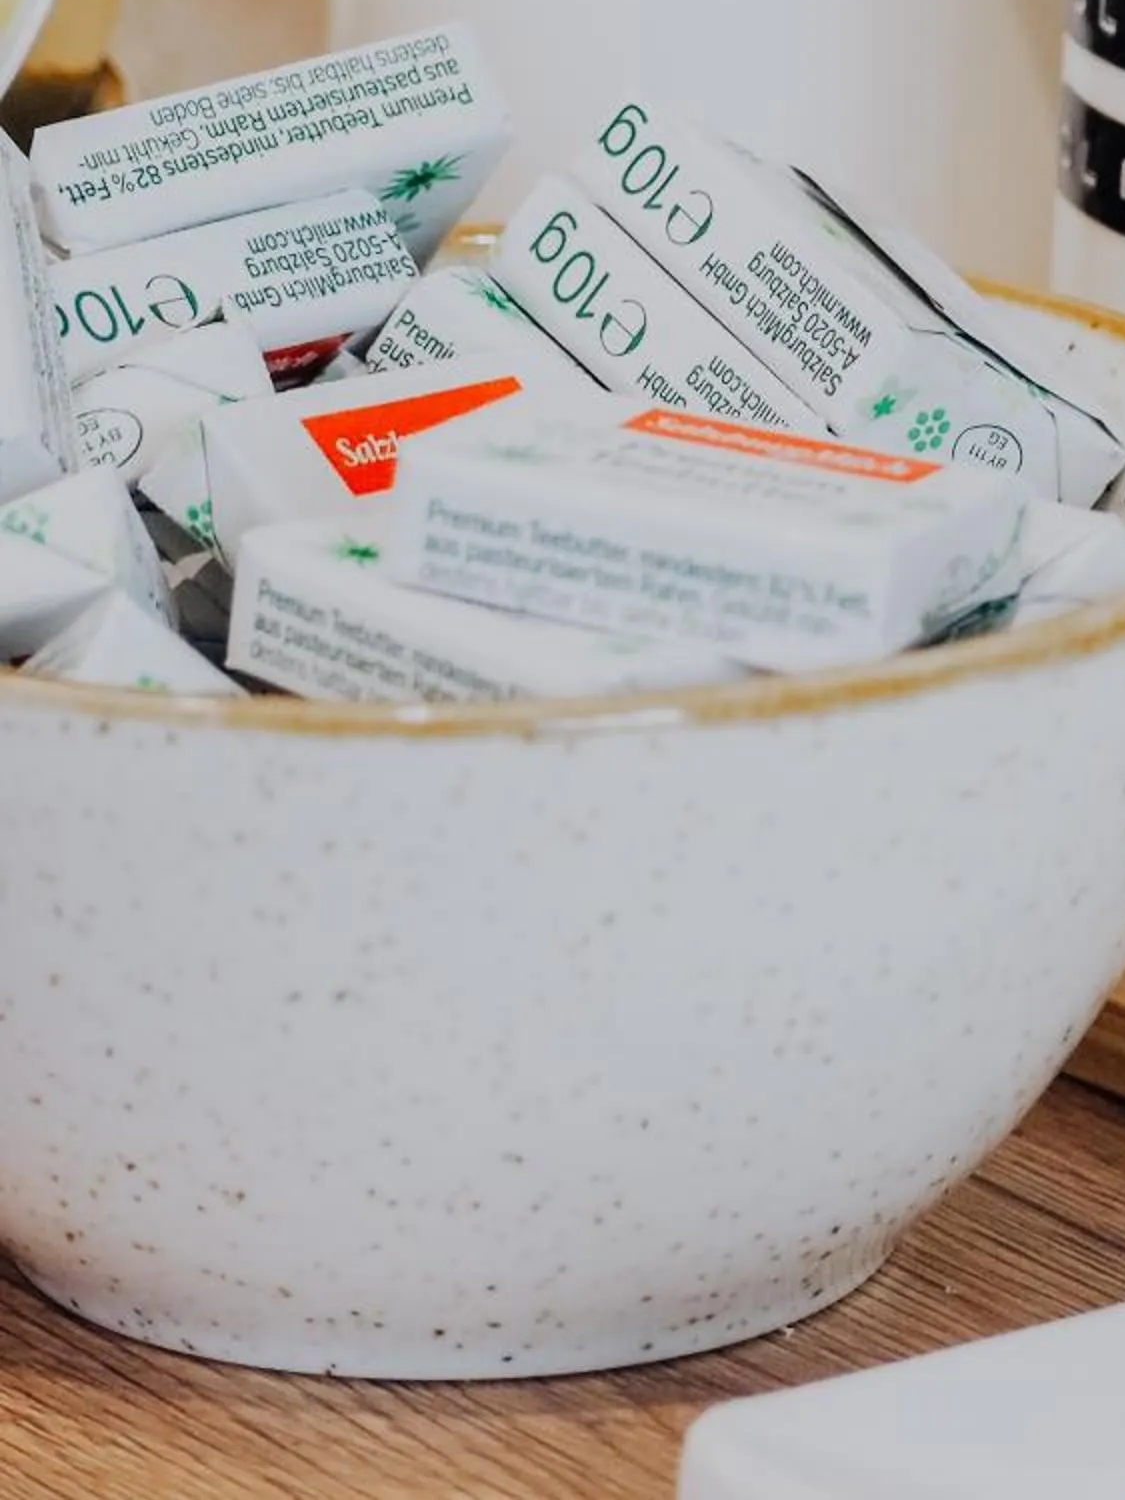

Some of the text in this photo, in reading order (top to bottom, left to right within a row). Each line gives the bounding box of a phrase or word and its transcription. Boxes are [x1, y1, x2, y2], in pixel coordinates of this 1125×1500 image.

[374, 34, 450, 67] destens
[307, 54, 376, 86] haltbar
[423, 58, 460, 81] aus
[216, 81, 268, 113] siehe
[266, 64, 422, 124] pasteurisiertem
[381, 83, 474, 119] Premium
[149, 96, 217, 132] Boden
[79, 148, 121, 171] min-
[122, 127, 201, 165] Gekühlt
[162, 132, 279, 177] mindestens
[58, 171, 112, 206] Fett,
[111, 164, 163, 194] 82%
[244, 226, 402, 279] A-5020 Salzburg
[228, 247, 416, 313] SalzburgMilch Gmb
[762, 240, 872, 348] www.milch.com
[699, 252, 844, 397] SalzburgMilch GmbH
[747, 251, 861, 371] A-5020 Salzburg
[379, 337, 415, 369] aus
[394, 309, 455, 361] Premi
